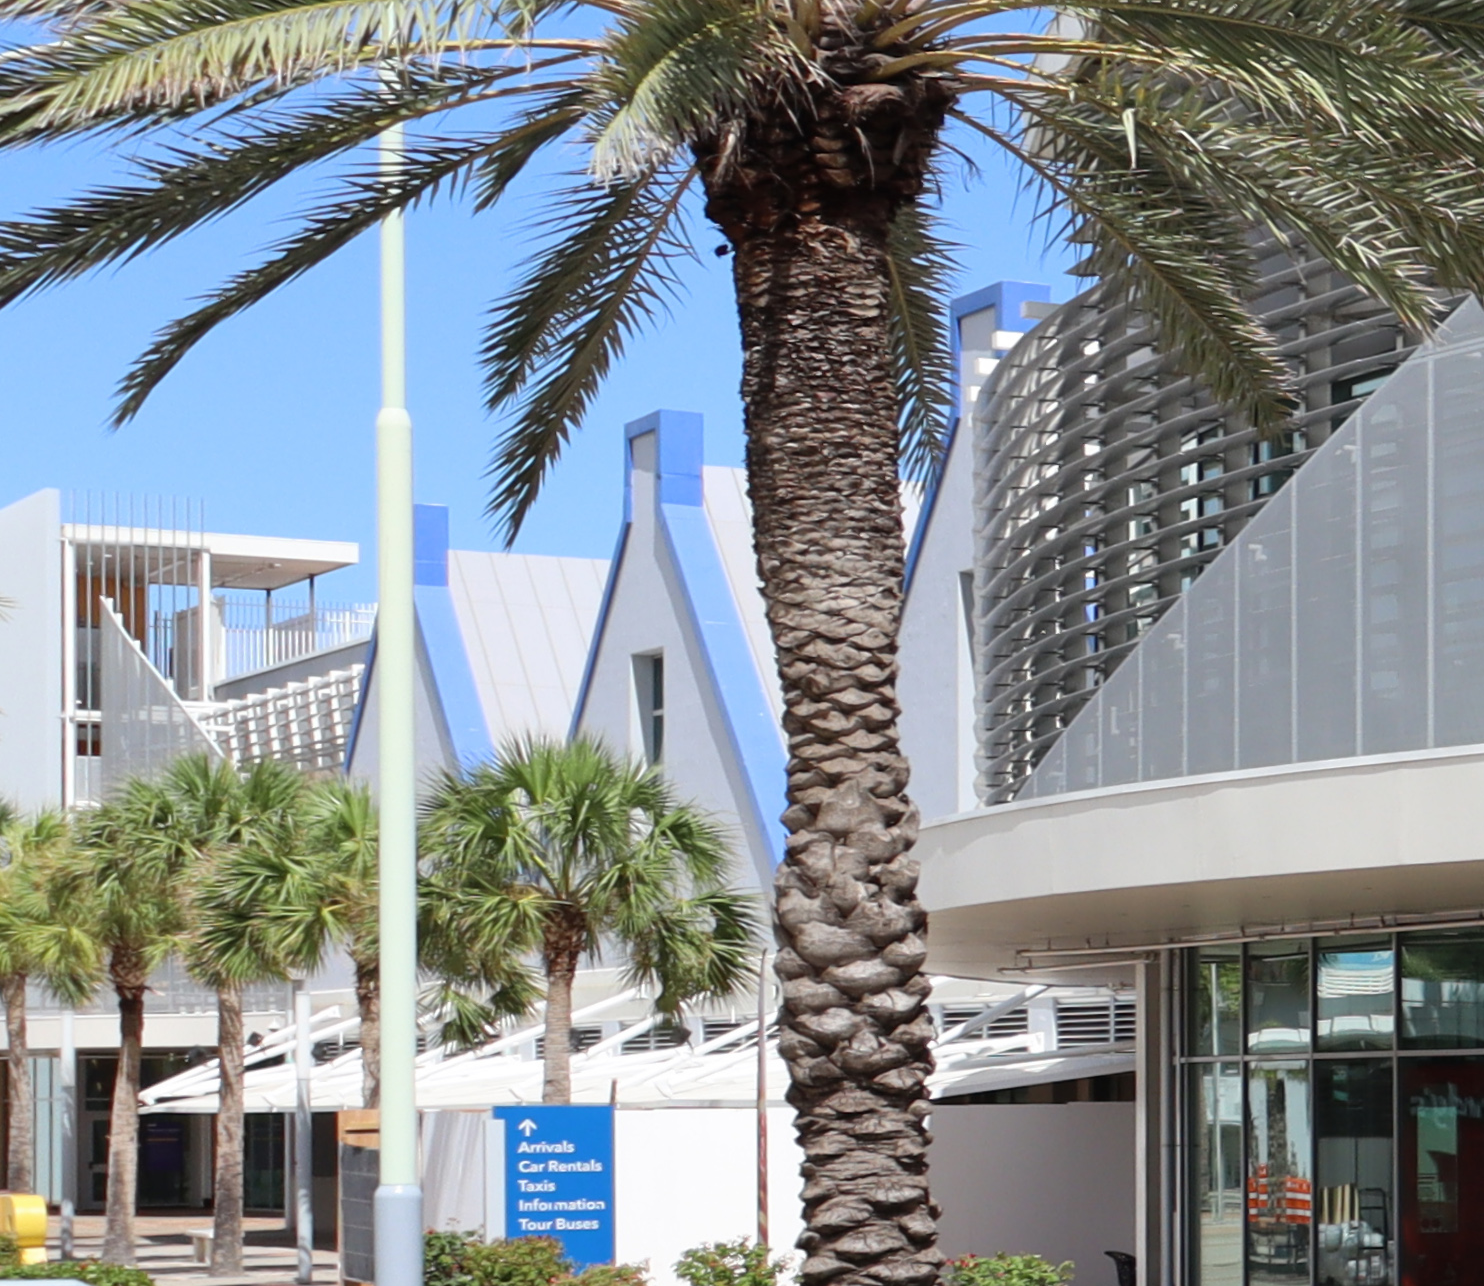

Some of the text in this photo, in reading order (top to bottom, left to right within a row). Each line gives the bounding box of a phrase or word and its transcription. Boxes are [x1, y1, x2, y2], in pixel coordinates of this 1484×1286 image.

[517, 1140, 575, 1154] Arrivals
[518, 1159, 602, 1173] Car Rentals
[517, 1179, 556, 1192] Taxis
[517, 1217, 599, 1231] Tour Buses
